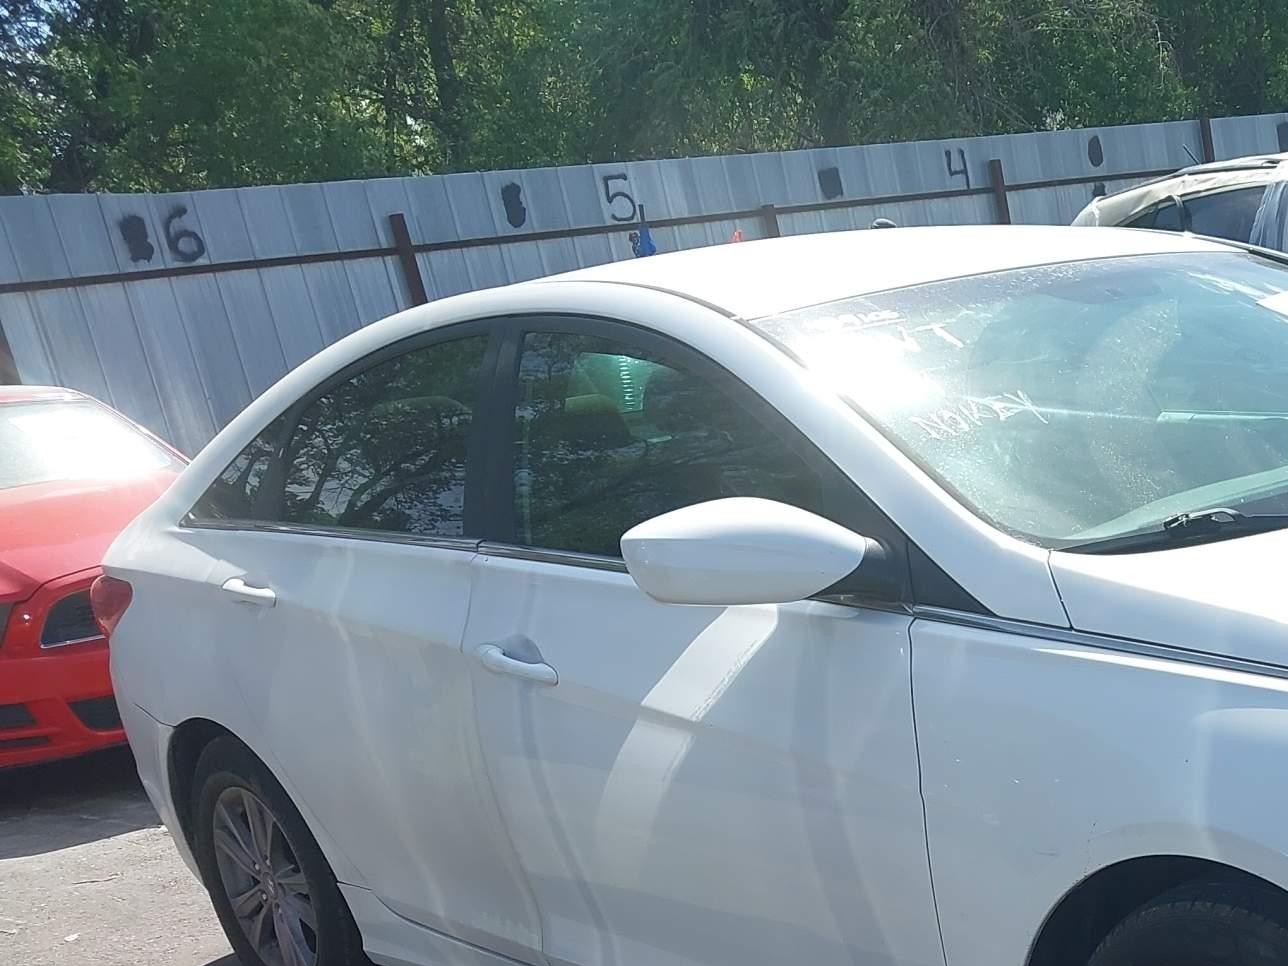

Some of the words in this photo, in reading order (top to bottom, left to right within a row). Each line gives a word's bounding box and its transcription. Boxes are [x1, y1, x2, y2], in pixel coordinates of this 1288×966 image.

[945, 149, 971, 190] 4
[603, 173, 637, 222] 5
[163, 205, 205, 263] 6
